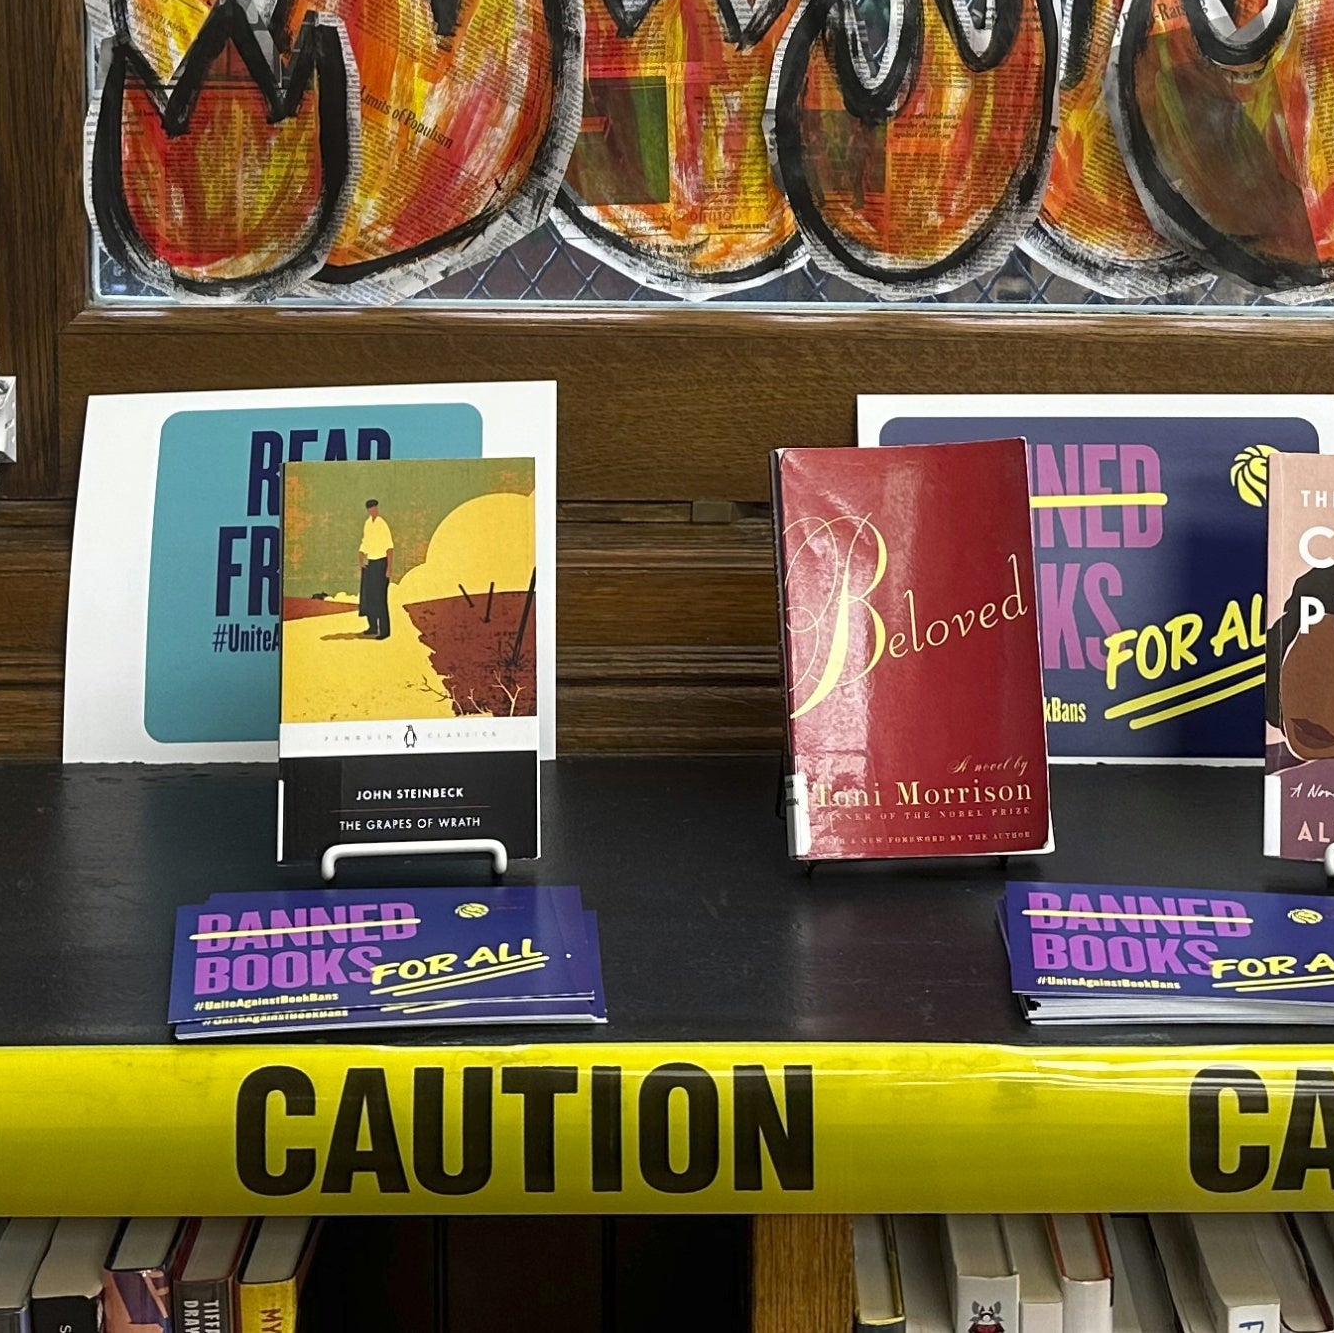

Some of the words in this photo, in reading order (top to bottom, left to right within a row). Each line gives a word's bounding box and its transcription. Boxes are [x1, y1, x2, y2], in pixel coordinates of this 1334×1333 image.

[405, 109, 454, 150] Populism
[1027, 443, 1164, 549] NED
[784, 512, 1029, 720] Beloved
[1104, 612, 1204, 691] FOR
[973, 755, 1013, 774] novel
[1013, 754, 1029, 778] by
[356, 789, 392, 801] JOHN
[396, 787, 465, 800] STEINBECK
[895, 778, 1033, 807] Morrison
[1289, 782, 1303, 798] A
[339, 820, 362, 831] THE
[366, 818, 413, 830] GRAPES
[417, 817, 434, 829] OF
[438, 816, 482, 828] WRATH
[880, 810, 897, 821] OF
[903, 810, 931, 820] THE
[938, 809, 984, 819] NOBEL
[991, 806, 1031, 816] PRIZE
[196, 901, 418, 954] BANNED
[1027, 891, 1253, 938] BANNED
[193, 946, 384, 995] BOOKS
[370, 952, 459, 985] FOR
[463, 938, 544, 968] ALL
[1030, 933, 1224, 977] BOOKS
[1208, 955, 1297, 980] FOR
[235, 1062, 816, 1197] CAUTION
